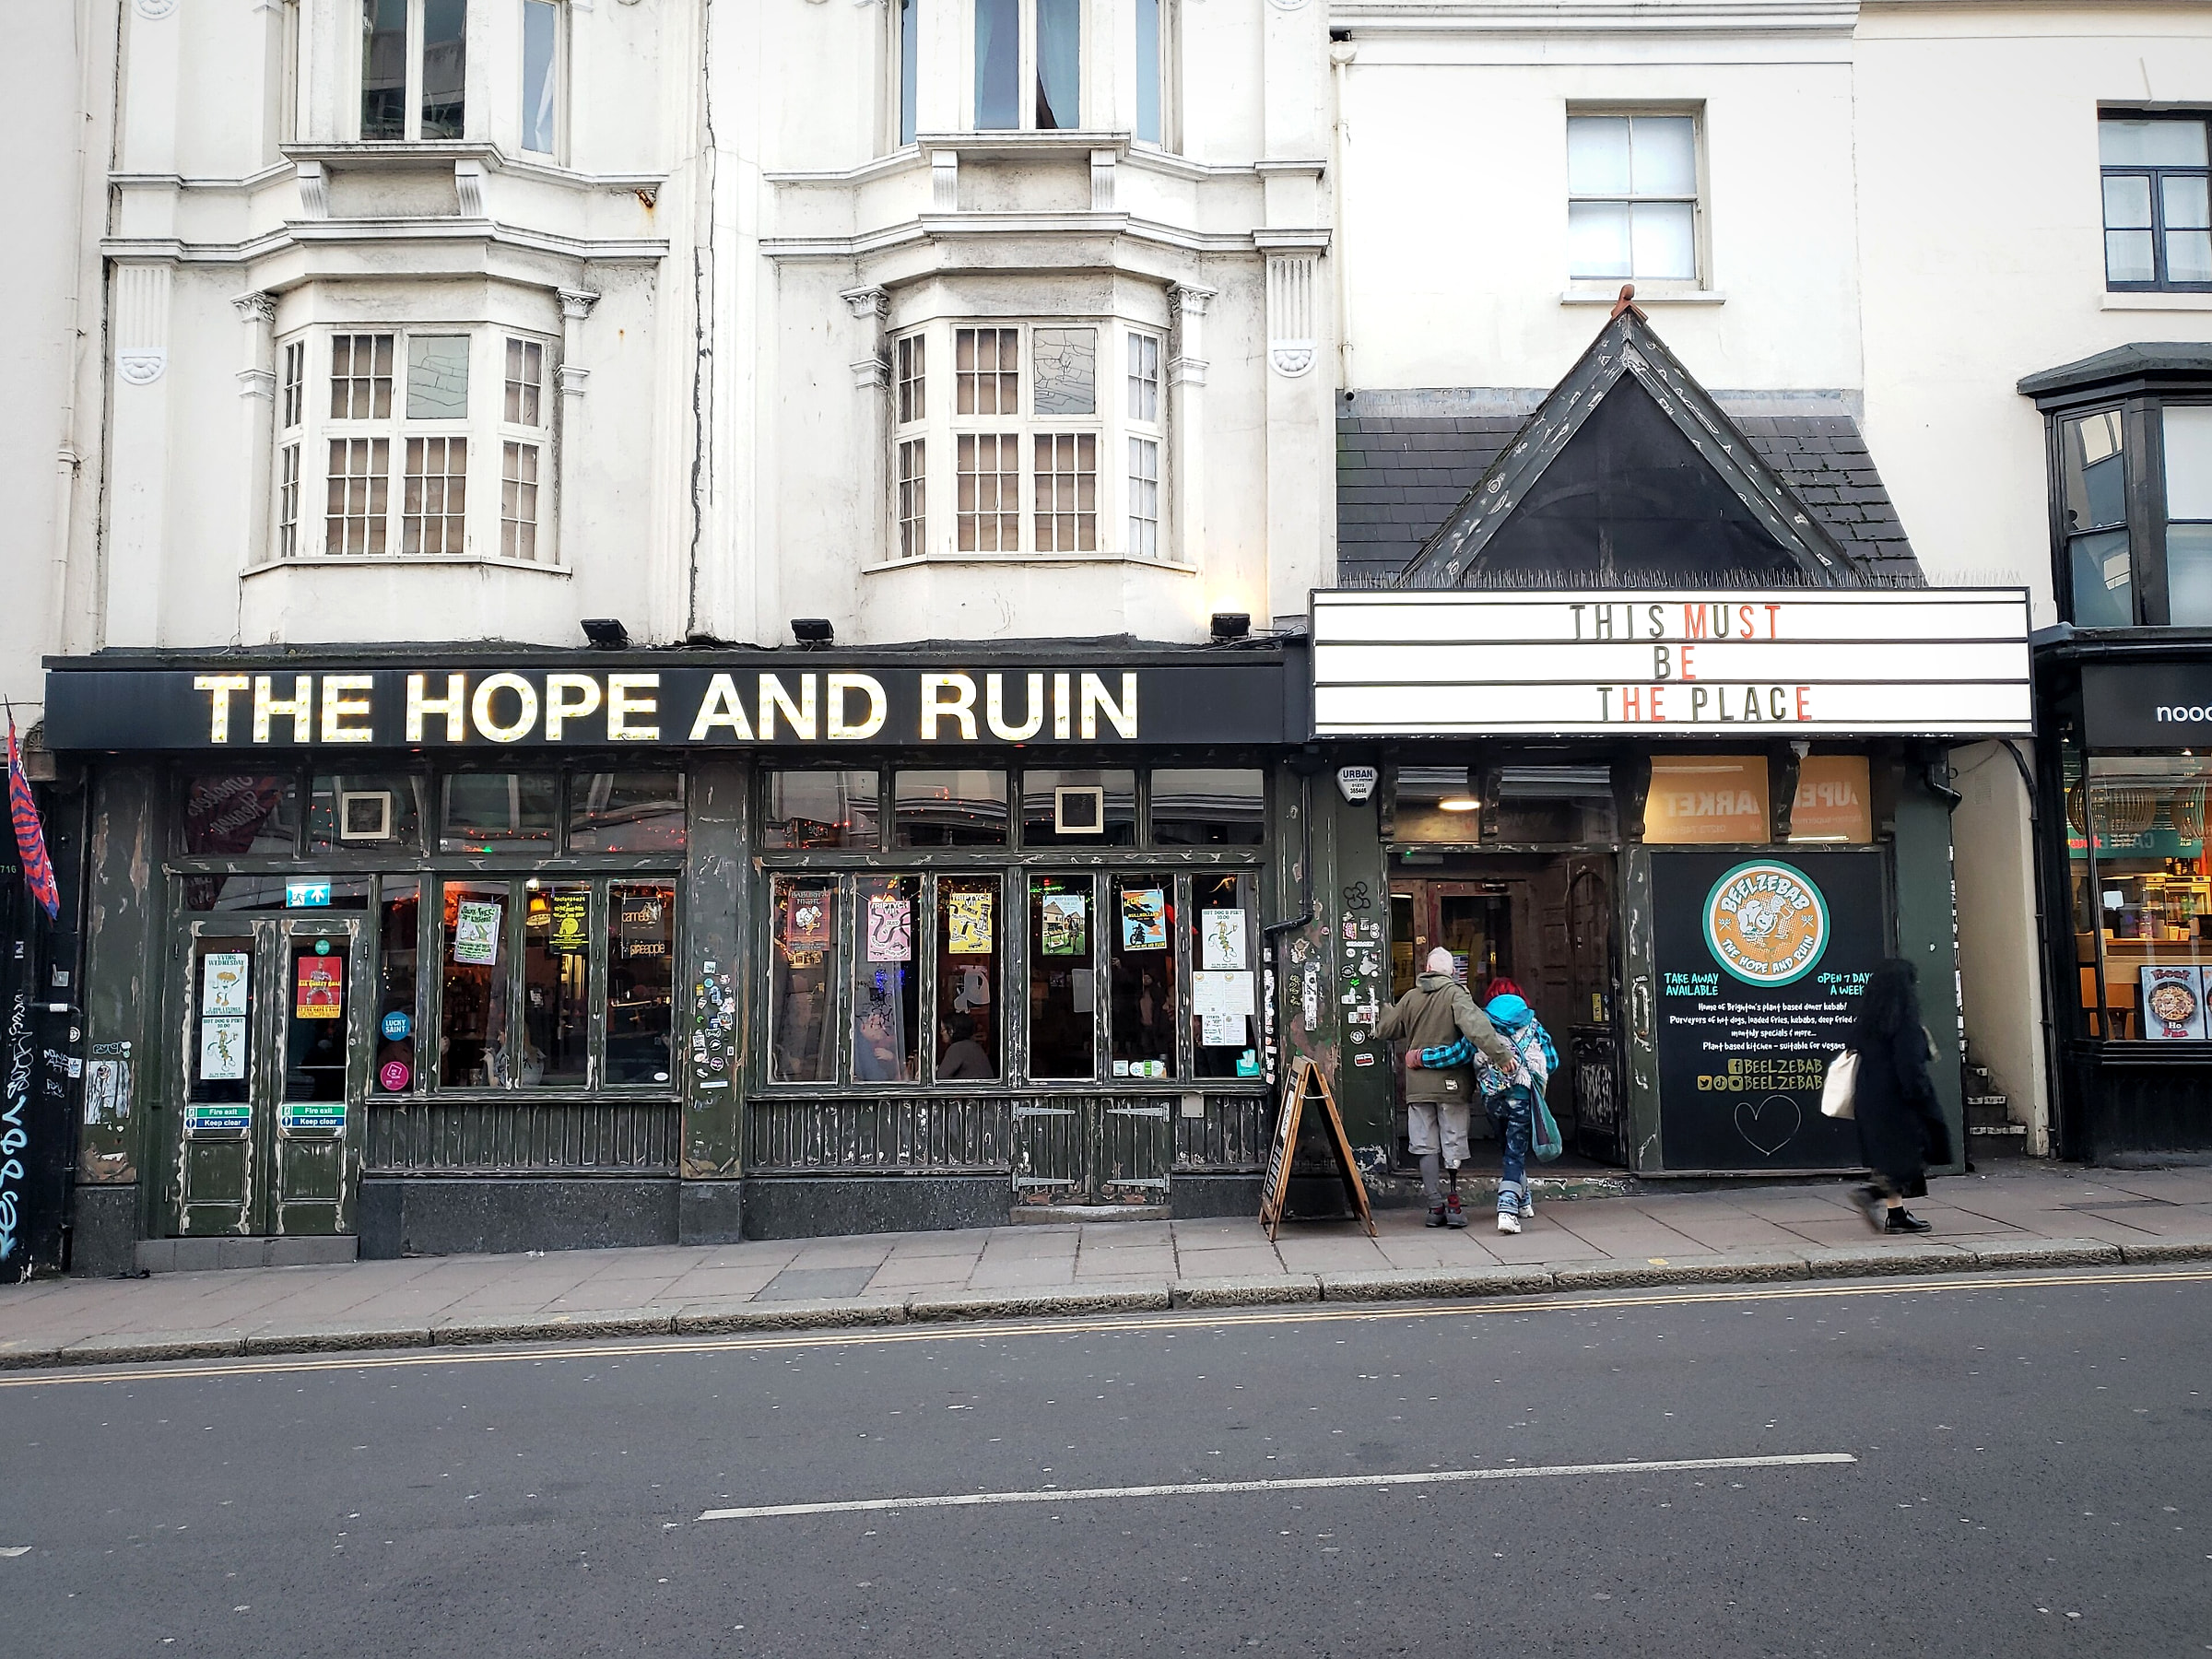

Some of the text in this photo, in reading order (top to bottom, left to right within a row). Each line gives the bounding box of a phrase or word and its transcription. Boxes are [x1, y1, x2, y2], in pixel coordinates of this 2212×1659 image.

[1570, 603, 1781, 640] THIS MUST
[1653, 645, 1697, 680] BE
[193, 672, 1138, 744] THE HOPE AND RUIN
[1596, 686, 1813, 722] THE PLACE
[1342, 770, 1373, 778] URBAN
[1720, 874, 1810, 913] BEELZEBAB
[1722, 935, 1815, 974] THE HOPE AND RUIN
[1664, 972, 1719, 985] TAKE AWAY
[1817, 972, 1842, 985] OPEN
[1843, 973, 1851, 984] 7
[1665, 984, 1720, 996] AVAILABLE
[1830, 986, 1837, 996] A
[1698, 1002, 1848, 1013] Home of Brighton's plant based doner kebab!
[1669, 1016, 1853, 1026] Purveyors of hot dogs, loaded fries, kebabs, deep fried
[2168, 1021, 2183, 1030] Ho
[1731, 1029, 1759, 1039] monthly
[1760, 1029, 1788, 1038] specials
[1702, 1041, 1724, 1052] Plant
[1724, 1041, 1745, 1051] based
[1746, 1041, 1772, 1052] kitchen
[1780, 1041, 1808, 1052] suitable
[1809, 1041, 1820, 1051] for
[1821, 1042, 1846, 1053] vegans
[1744, 1058, 1823, 1074] BEELZEBAB
[1744, 1074, 1823, 1090] BEELZEBAB
[204, 1119, 223, 1127] Keep
[300, 1118, 320, 1126] Keep
